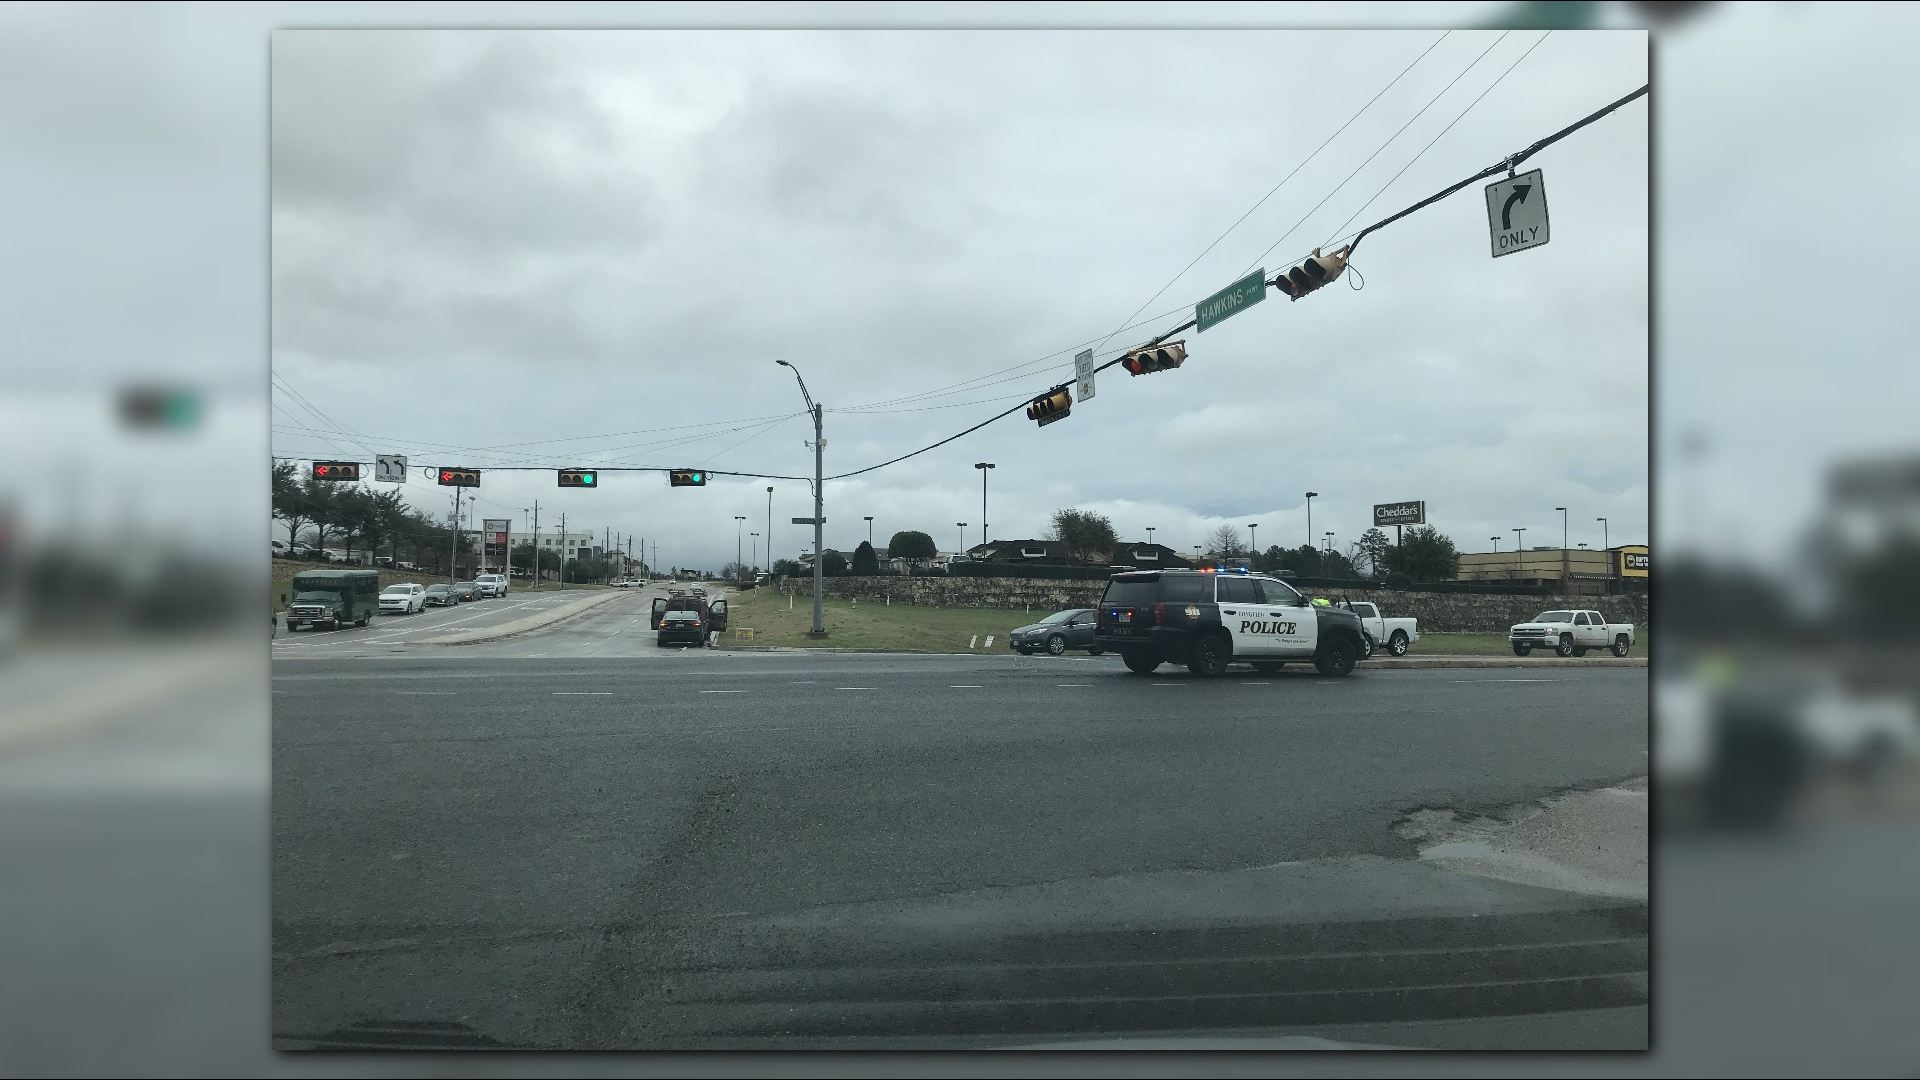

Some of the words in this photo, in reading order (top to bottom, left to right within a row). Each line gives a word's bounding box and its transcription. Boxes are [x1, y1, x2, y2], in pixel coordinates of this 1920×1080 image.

[1500, 226, 1539, 248] ONLY
[1201, 289, 1242, 323] HAWKINS
[1376, 504, 1418, 518] Cheddar's
[1239, 620, 1296, 635] POLICE
